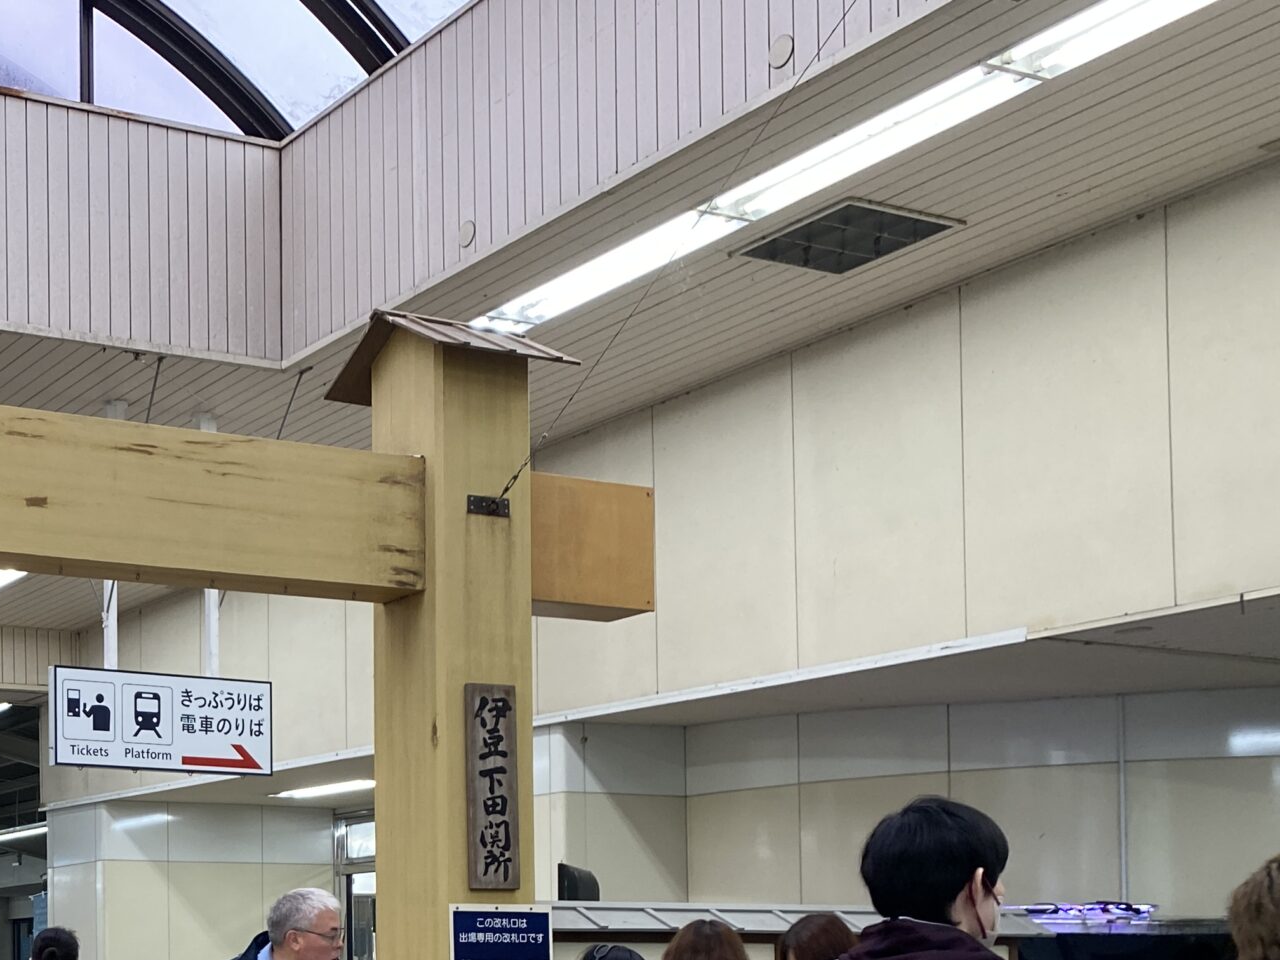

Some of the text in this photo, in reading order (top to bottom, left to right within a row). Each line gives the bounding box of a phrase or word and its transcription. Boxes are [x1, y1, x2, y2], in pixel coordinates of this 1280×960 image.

[180, 688, 265, 712] きっぷうりば
[180, 714, 265, 737] 電車のりば
[69, 745, 109, 757] Tickets
[124, 747, 172, 760] Platform
[474, 696, 512, 882] 伊豆下田関所
[476, 918, 527, 928] この改札口は
